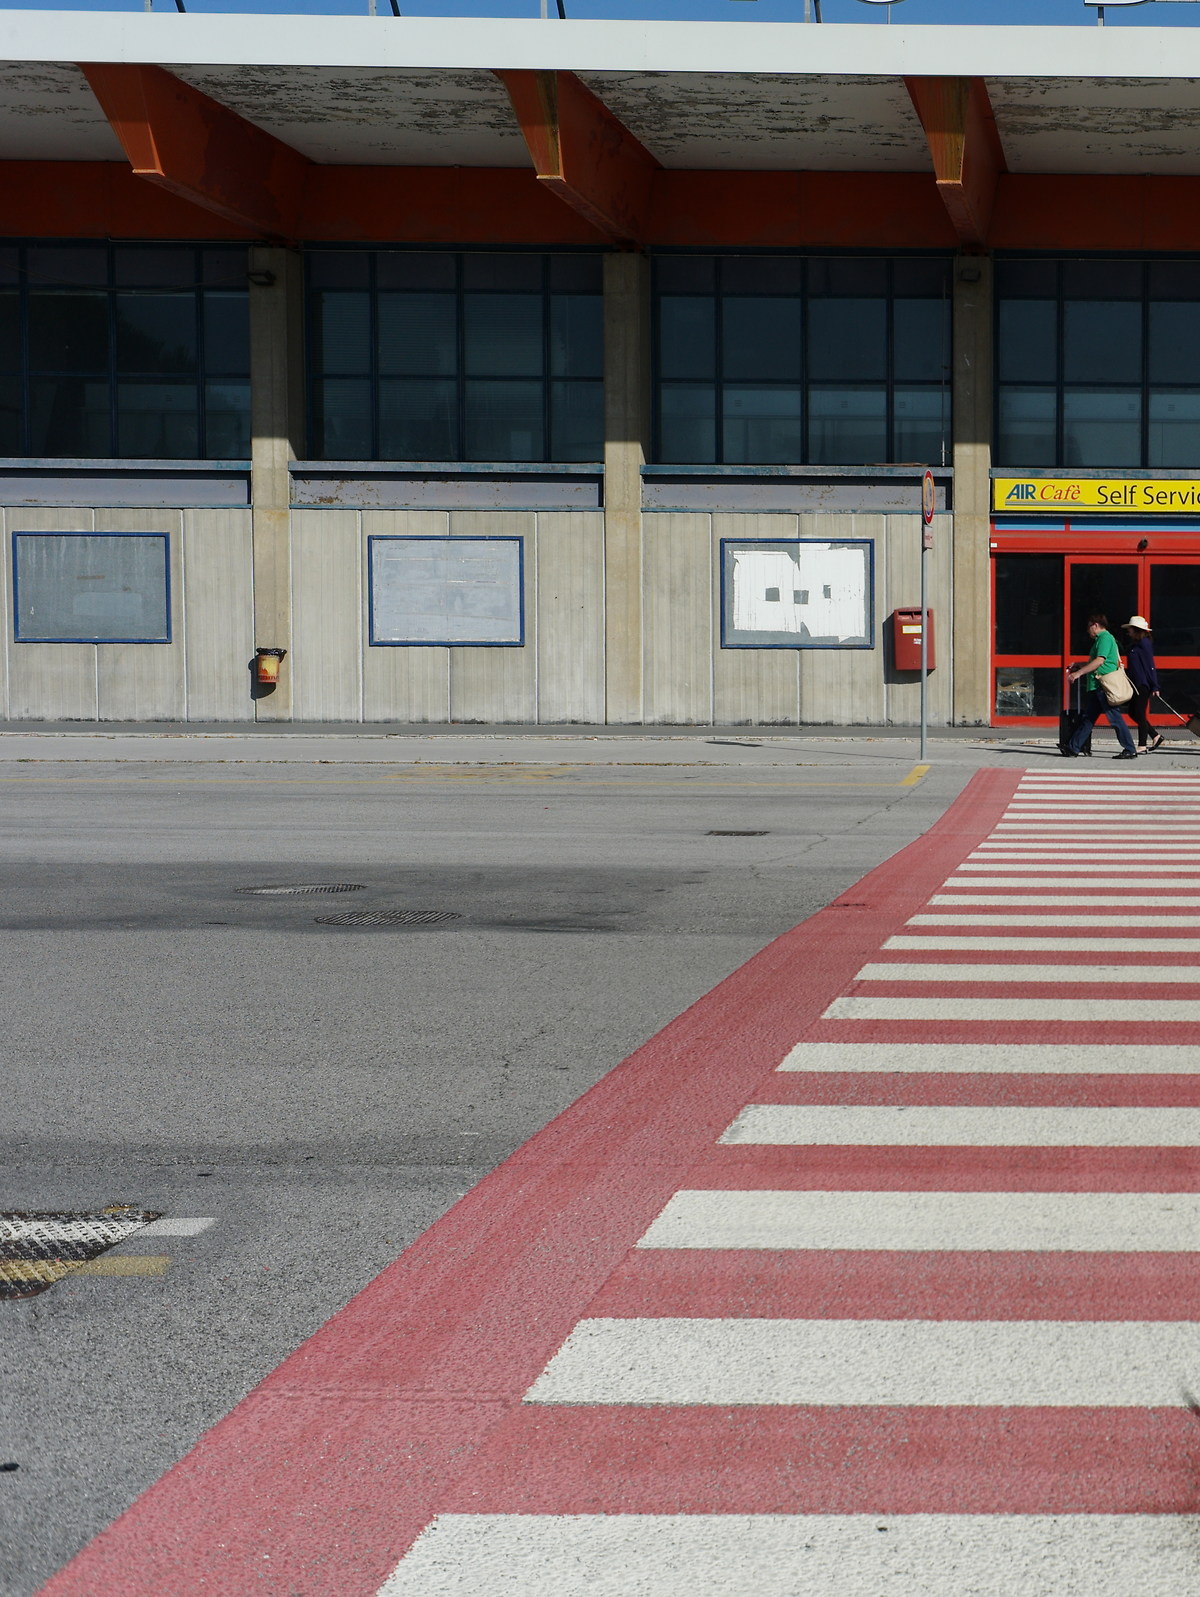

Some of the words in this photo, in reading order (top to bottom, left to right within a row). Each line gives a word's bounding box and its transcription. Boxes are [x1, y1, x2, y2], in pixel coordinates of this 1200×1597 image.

[1006, 484, 1036, 500] AIR
[1040, 484, 1081, 500] Cafè
[1097, 485, 1138, 505] Self
